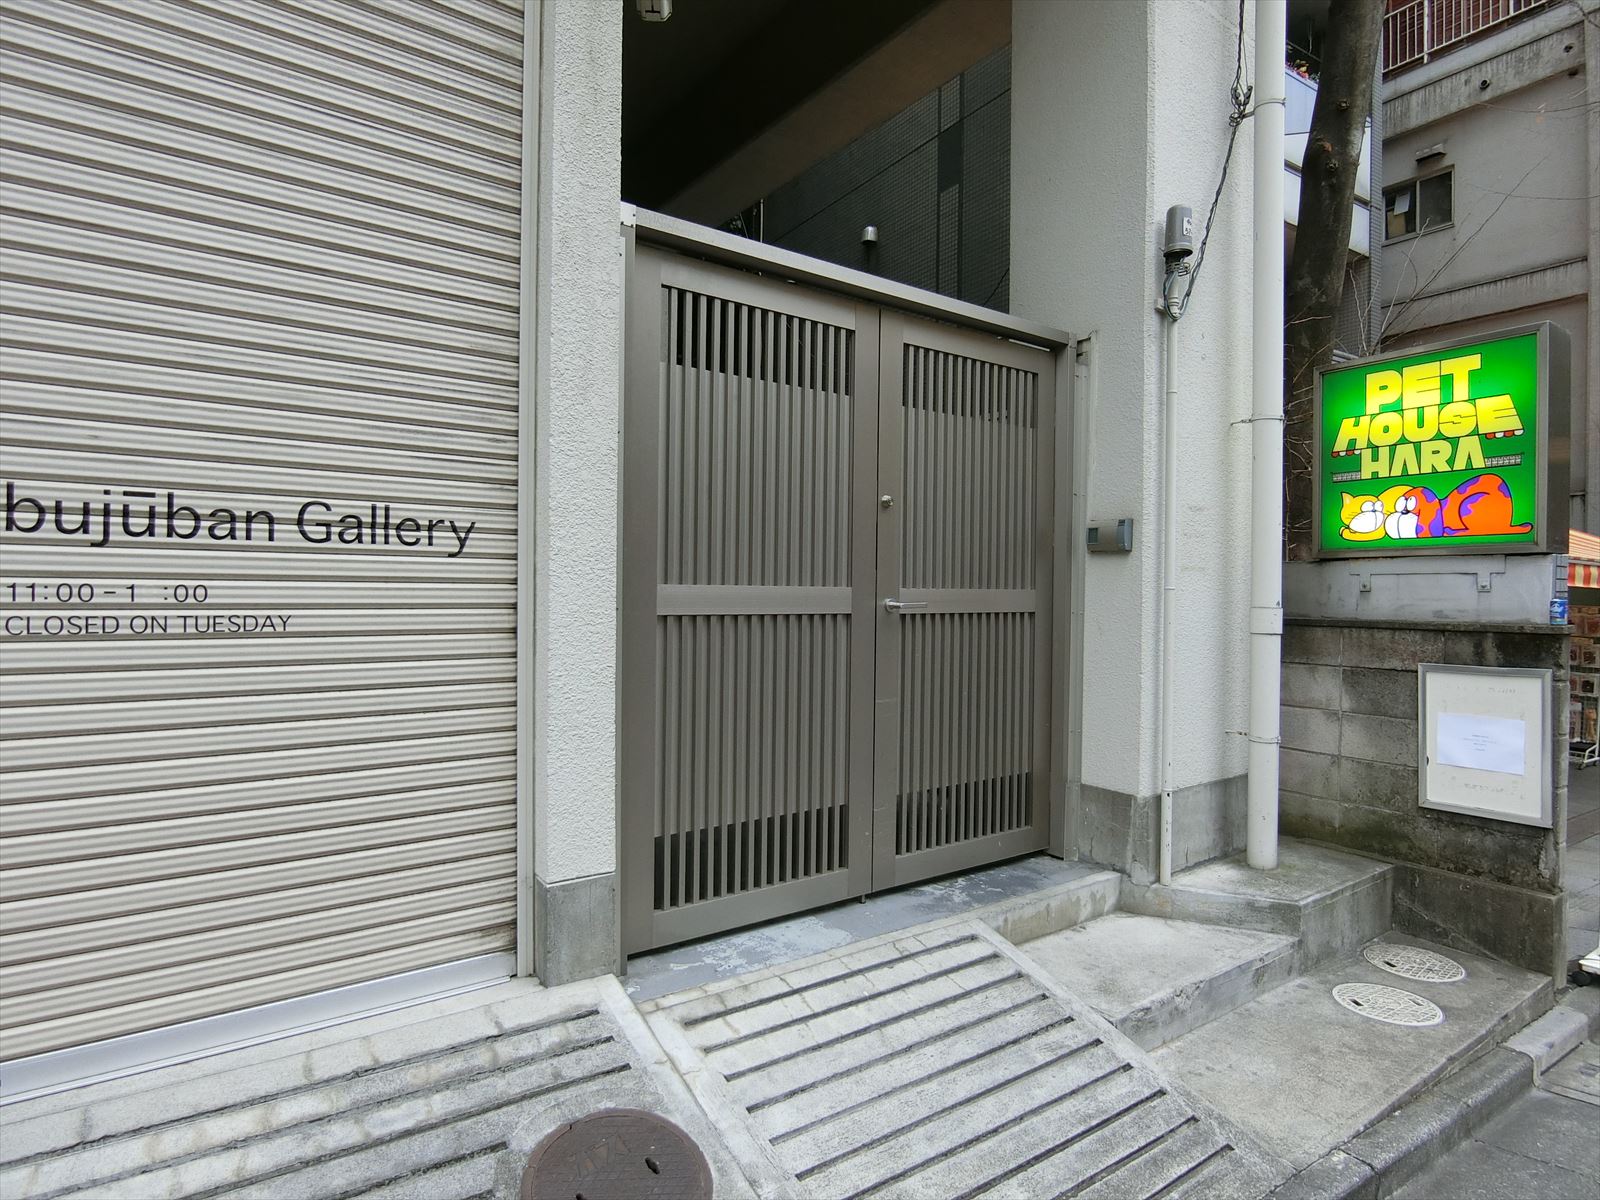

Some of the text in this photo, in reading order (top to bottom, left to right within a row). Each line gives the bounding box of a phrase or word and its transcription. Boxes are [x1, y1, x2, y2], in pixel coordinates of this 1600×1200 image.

[1365, 353, 1482, 415] PET
[1332, 394, 1524, 453] HOUSE
[1360, 435, 1486, 480] HARA
[296, 500, 476, 557] Gallery
[5, 614, 292, 635] CLOSED ON TUESDAY
